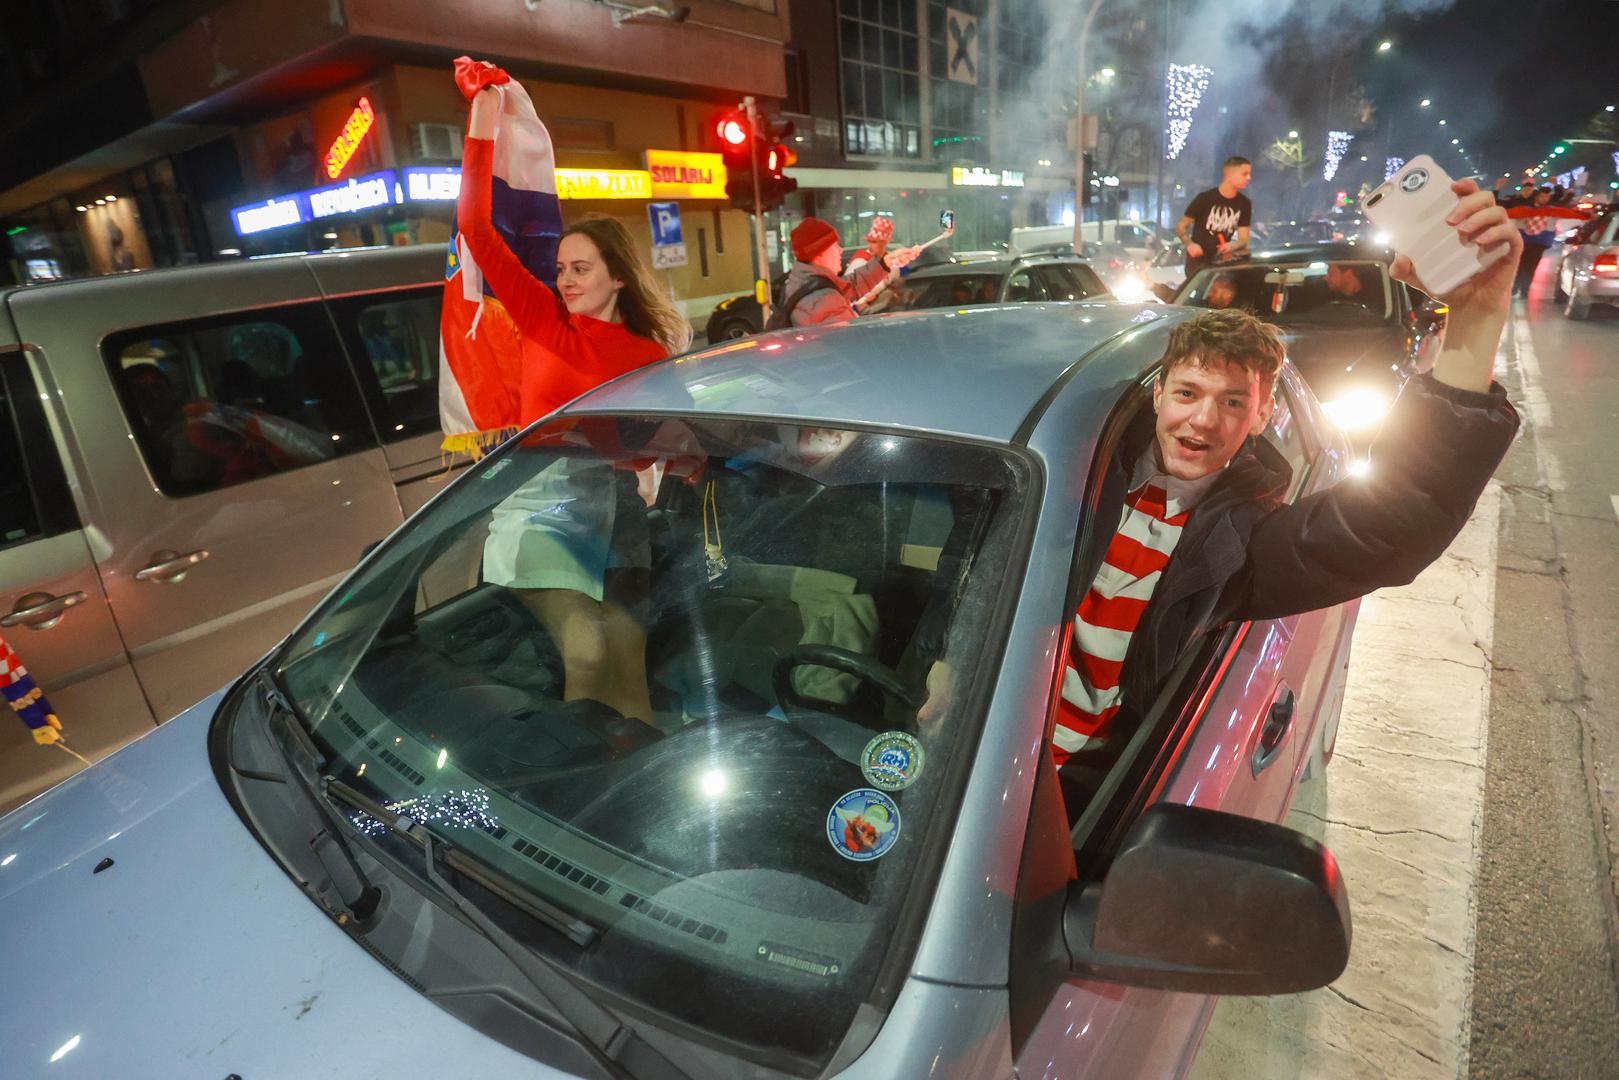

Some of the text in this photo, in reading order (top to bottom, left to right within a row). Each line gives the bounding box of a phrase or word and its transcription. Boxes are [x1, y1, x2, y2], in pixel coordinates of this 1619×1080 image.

[555, 175, 600, 192] TKUP
[652, 165, 712, 184] SOLARIJ
[658, 210, 673, 237] P
